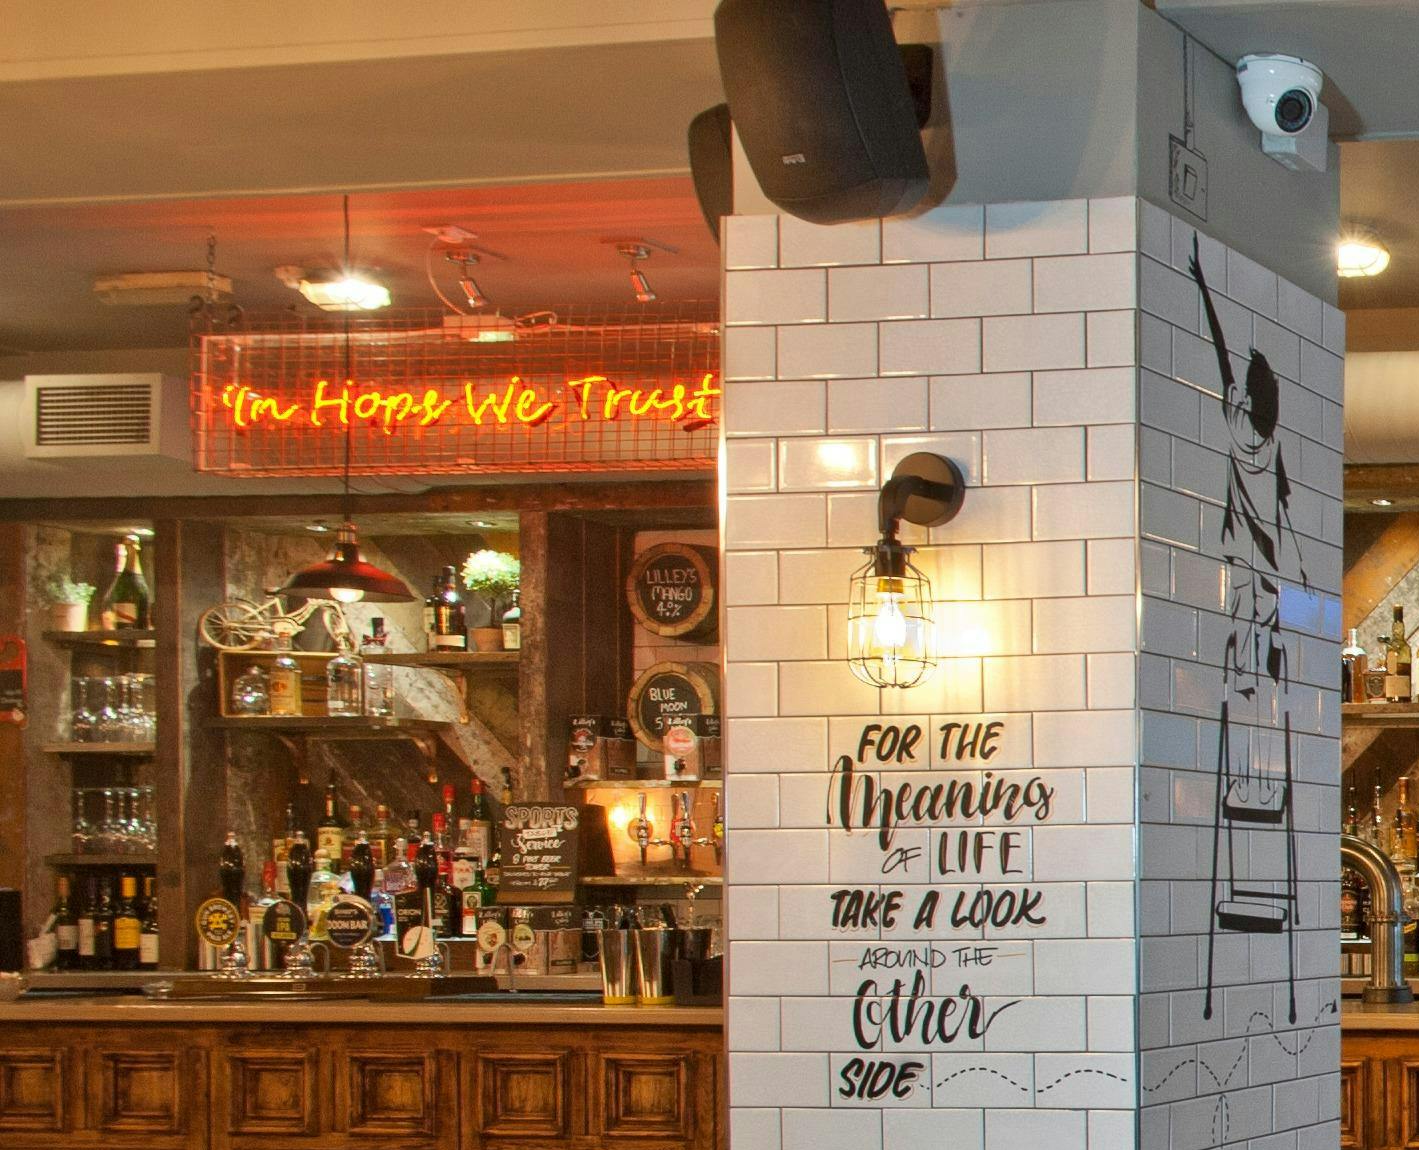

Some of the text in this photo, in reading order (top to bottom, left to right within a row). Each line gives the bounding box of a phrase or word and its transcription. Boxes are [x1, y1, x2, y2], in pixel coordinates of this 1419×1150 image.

[311, 380, 452, 435] Hops
[464, 376, 553, 425] We
[568, 373, 721, 421] Trust
[651, 585, 693, 601] MANGO
[649, 687, 676, 701] BLUE
[660, 701, 688, 713] MOON
[858, 722, 1004, 763] FOR THE
[505, 806, 579, 831] SPORTS
[827, 755, 1054, 851] Meaning
[881, 830, 1023, 875] OF LIFE
[830, 888, 1046, 929] TAKE A LOOK
[858, 947, 999, 970] AROUND THE
[853, 969, 1022, 1050] Other
[838, 1057, 925, 1098] SIDE
